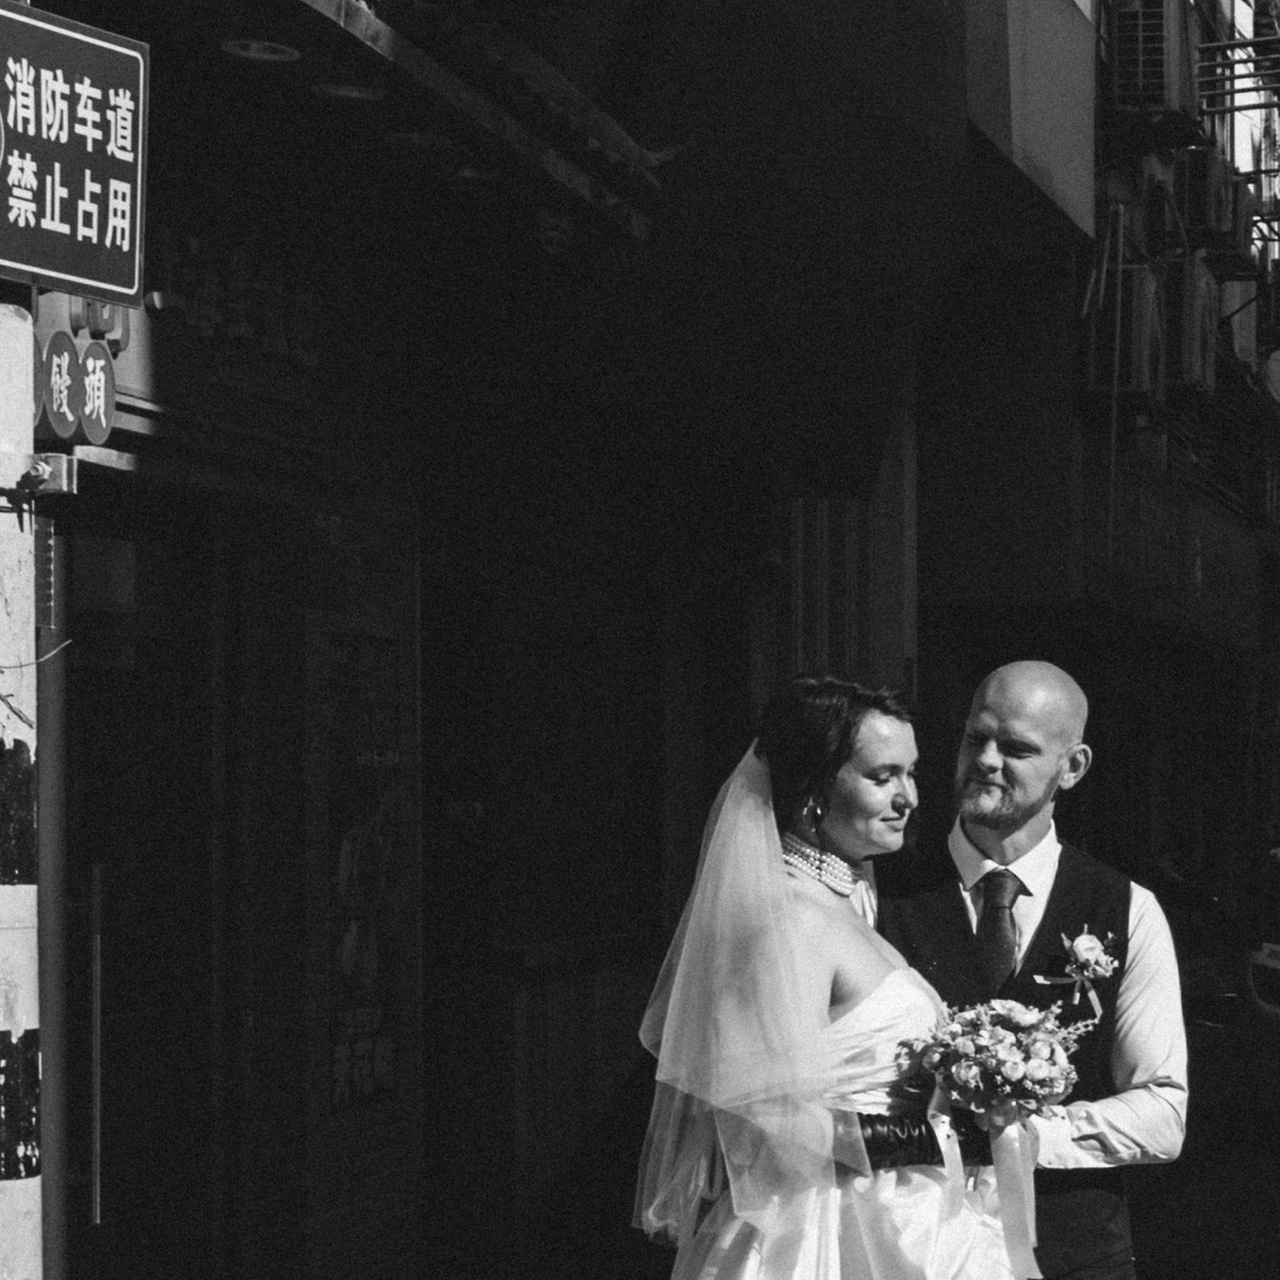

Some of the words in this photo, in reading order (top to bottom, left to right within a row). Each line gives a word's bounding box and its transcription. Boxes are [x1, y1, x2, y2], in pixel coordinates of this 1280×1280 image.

[4, 56, 134, 163] 消防车道
[6, 149, 131, 253] 禁止占用
